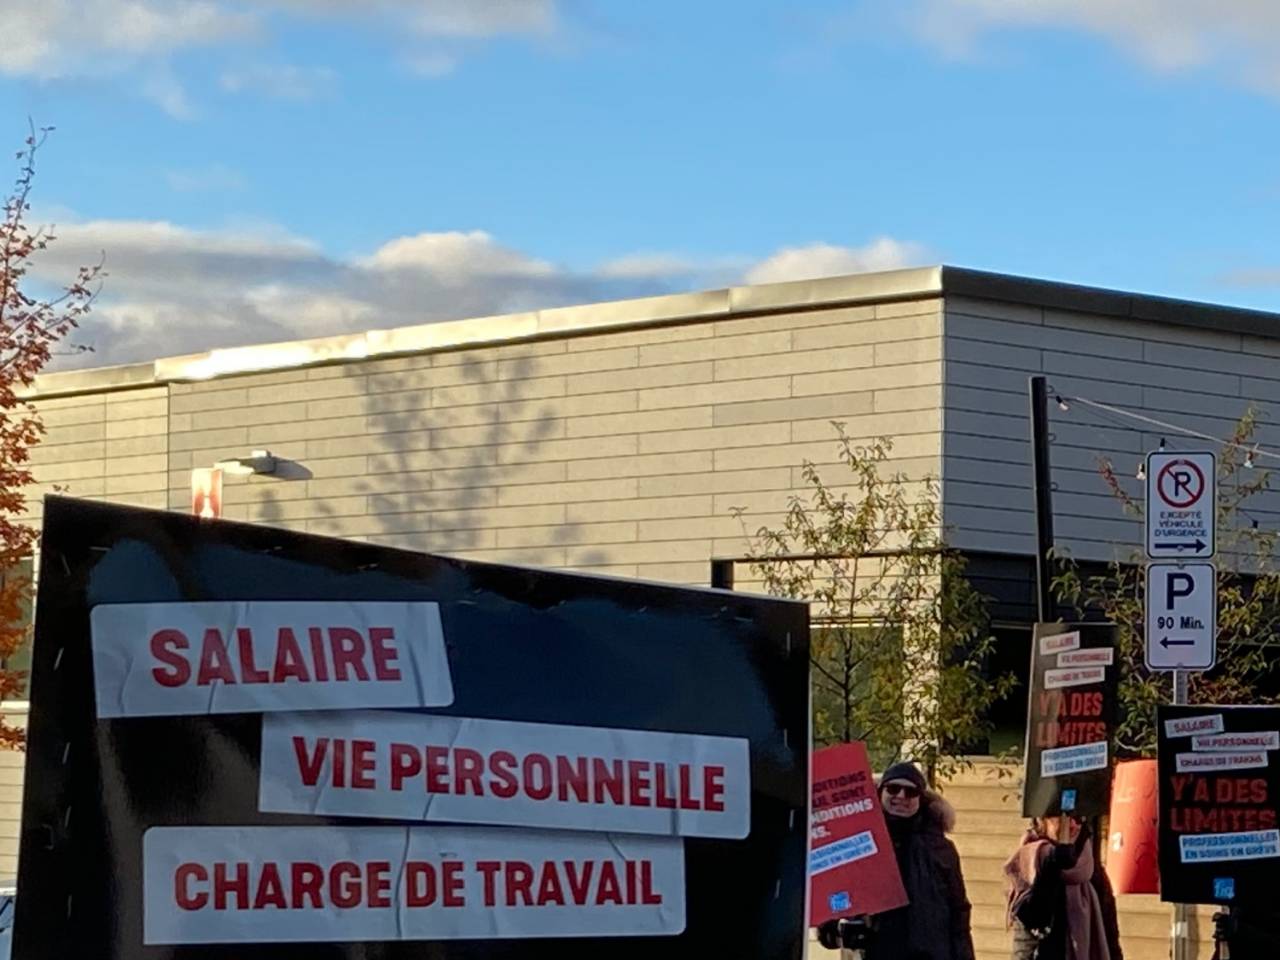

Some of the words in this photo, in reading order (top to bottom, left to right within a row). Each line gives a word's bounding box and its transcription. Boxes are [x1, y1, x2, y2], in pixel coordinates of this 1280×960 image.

[1167, 573, 1194, 610] P
[1157, 616, 1174, 629] 90
[1180, 616, 1205, 629] Min.
[151, 627, 402, 688] SALAIRE
[1070, 693, 1103, 716] DES
[1036, 721, 1106, 749] LIMITES
[292, 736, 376, 790] VIE
[390, 744, 726, 812] PERSONNELLE
[1170, 774, 1209, 802] Y'A
[1216, 778, 1268, 803] DES
[811, 798, 873, 824] NDITIONS
[1170, 807, 1276, 832] LIMITES
[174, 862, 391, 910] CHARGE
[406, 862, 464, 908] DE
[476, 860, 662, 907] TRAVAIL
